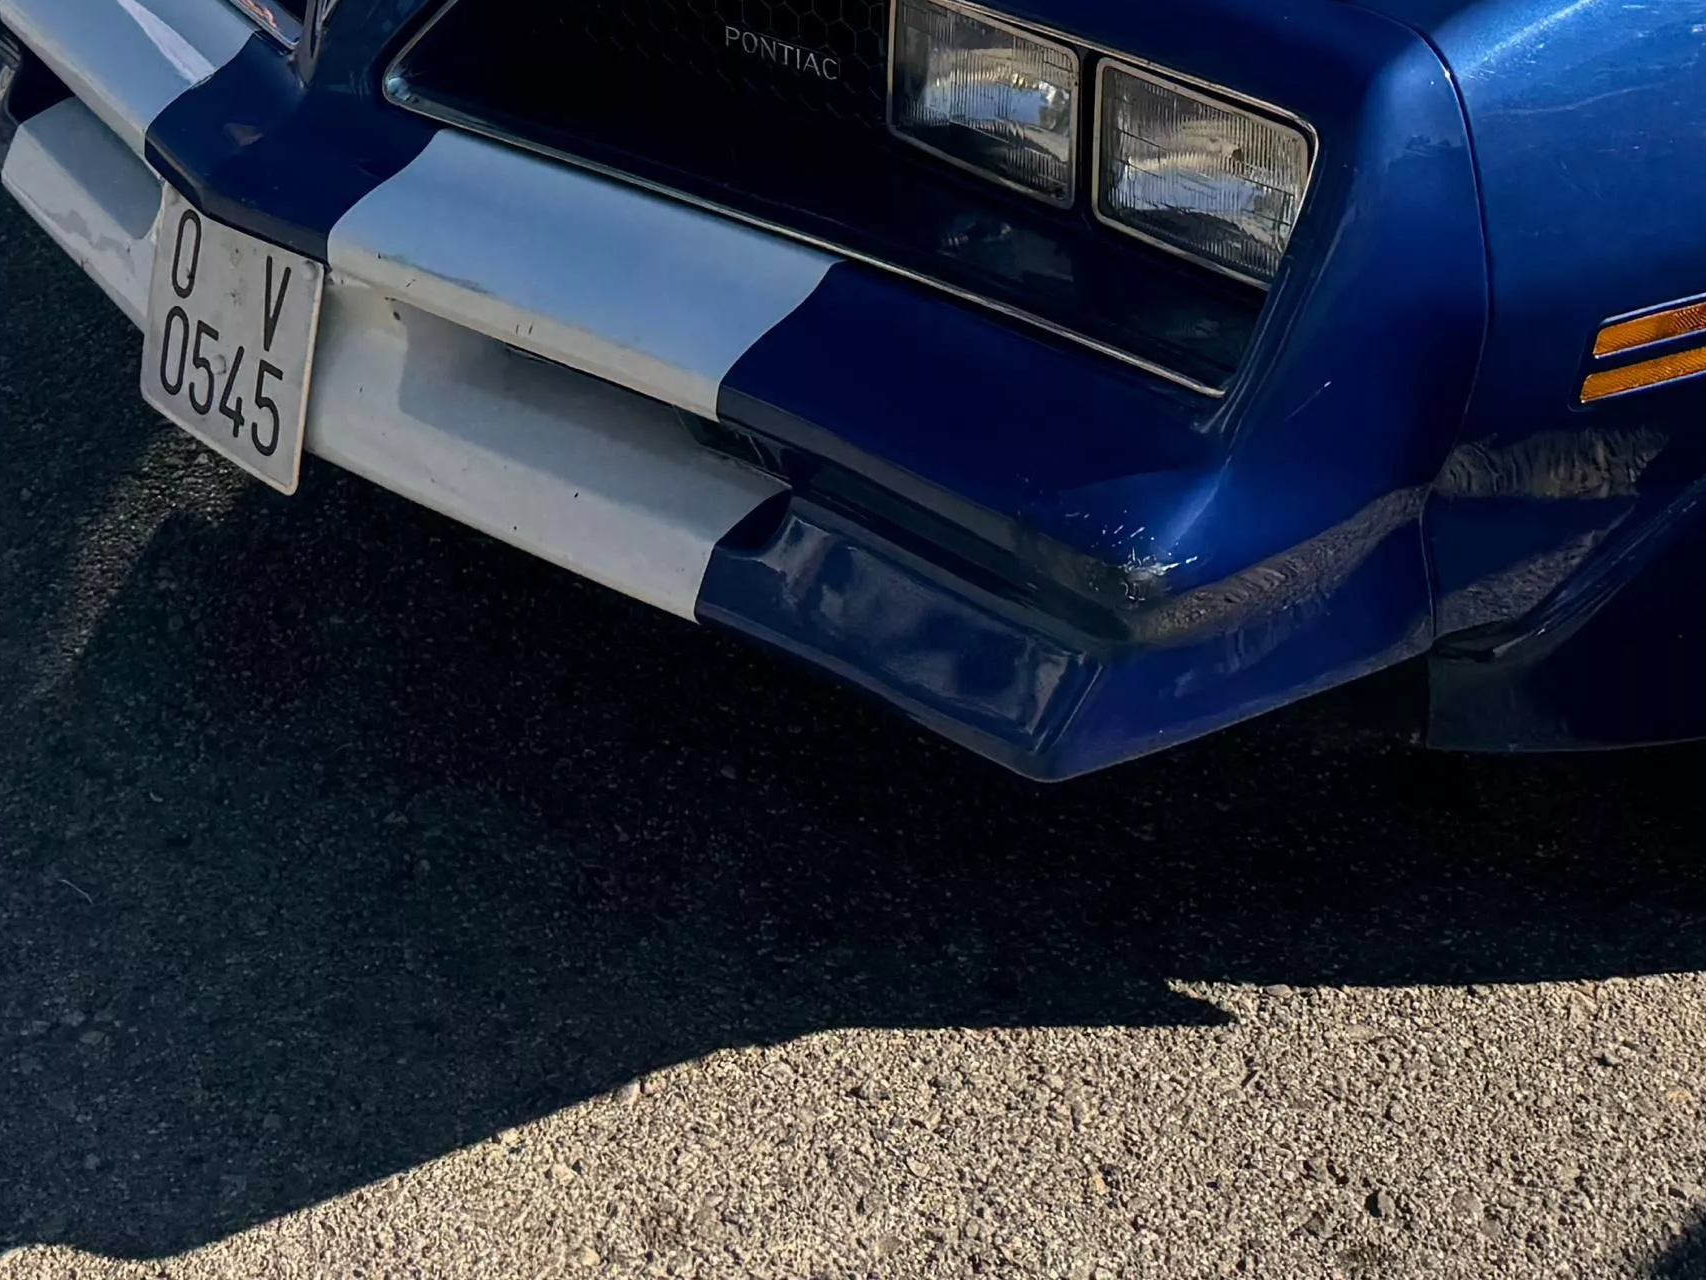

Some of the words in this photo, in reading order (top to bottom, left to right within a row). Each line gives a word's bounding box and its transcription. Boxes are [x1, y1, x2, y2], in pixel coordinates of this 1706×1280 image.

[725, 25, 838, 80] PONTIAC
[263, 255, 291, 352] V
[159, 306, 284, 456] 0545
